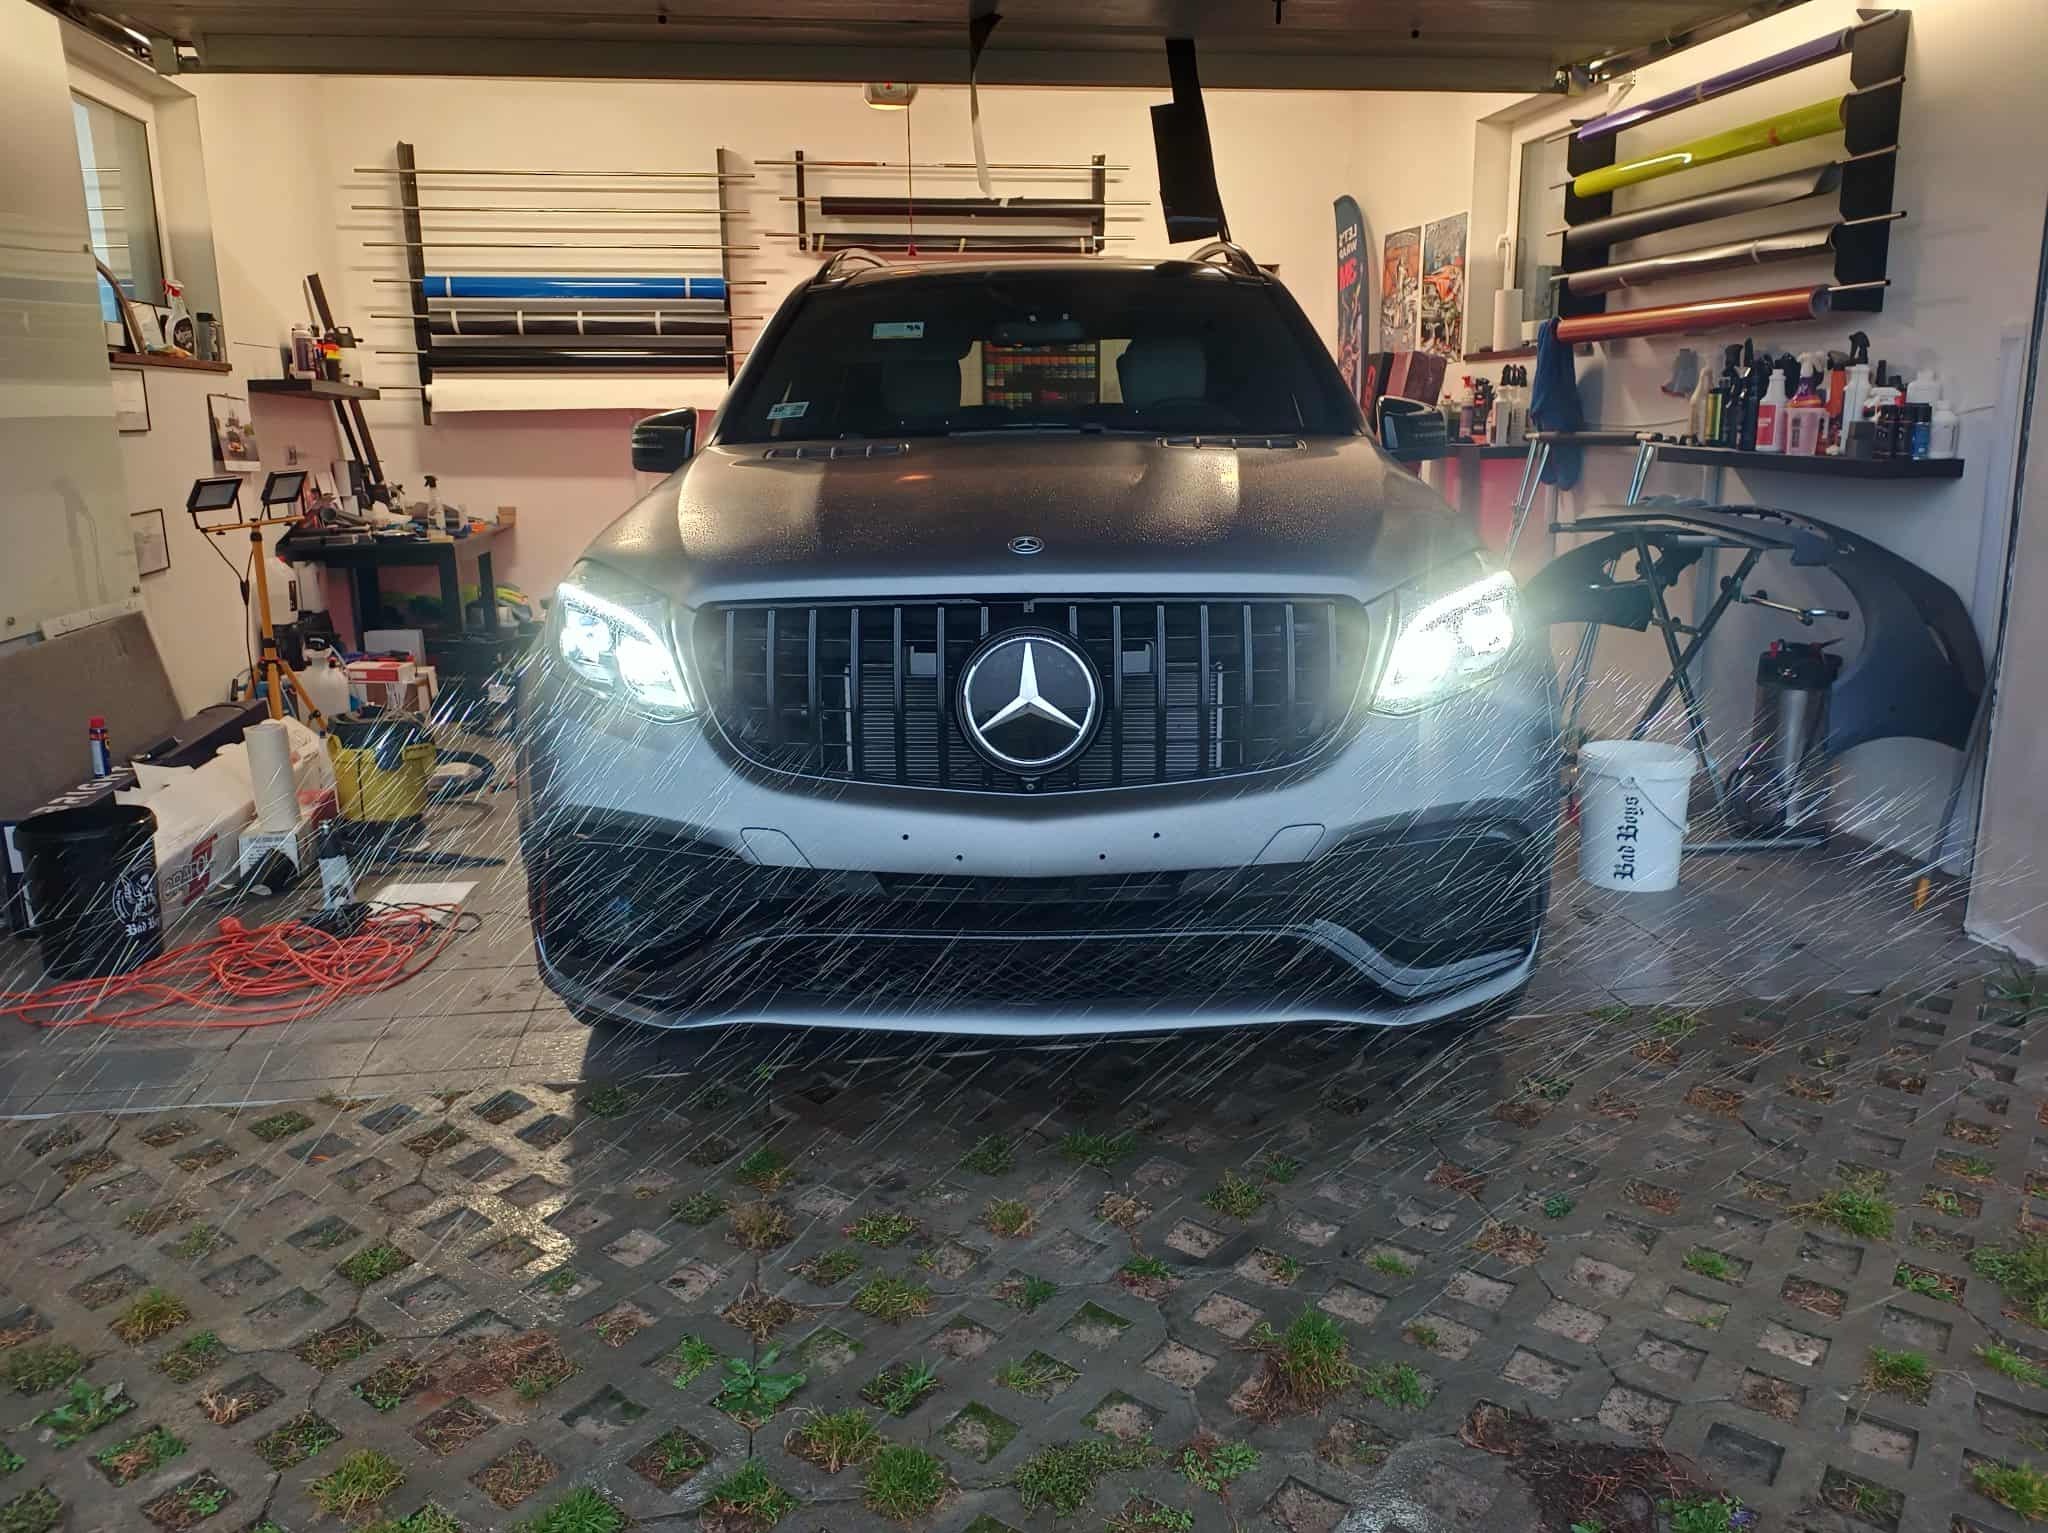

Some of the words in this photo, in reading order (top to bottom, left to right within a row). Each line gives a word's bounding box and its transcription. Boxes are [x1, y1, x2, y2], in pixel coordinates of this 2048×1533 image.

[1616, 796, 1645, 842] Boys
[1613, 845, 1636, 881] Bad
[125, 921, 147, 937] Bad
